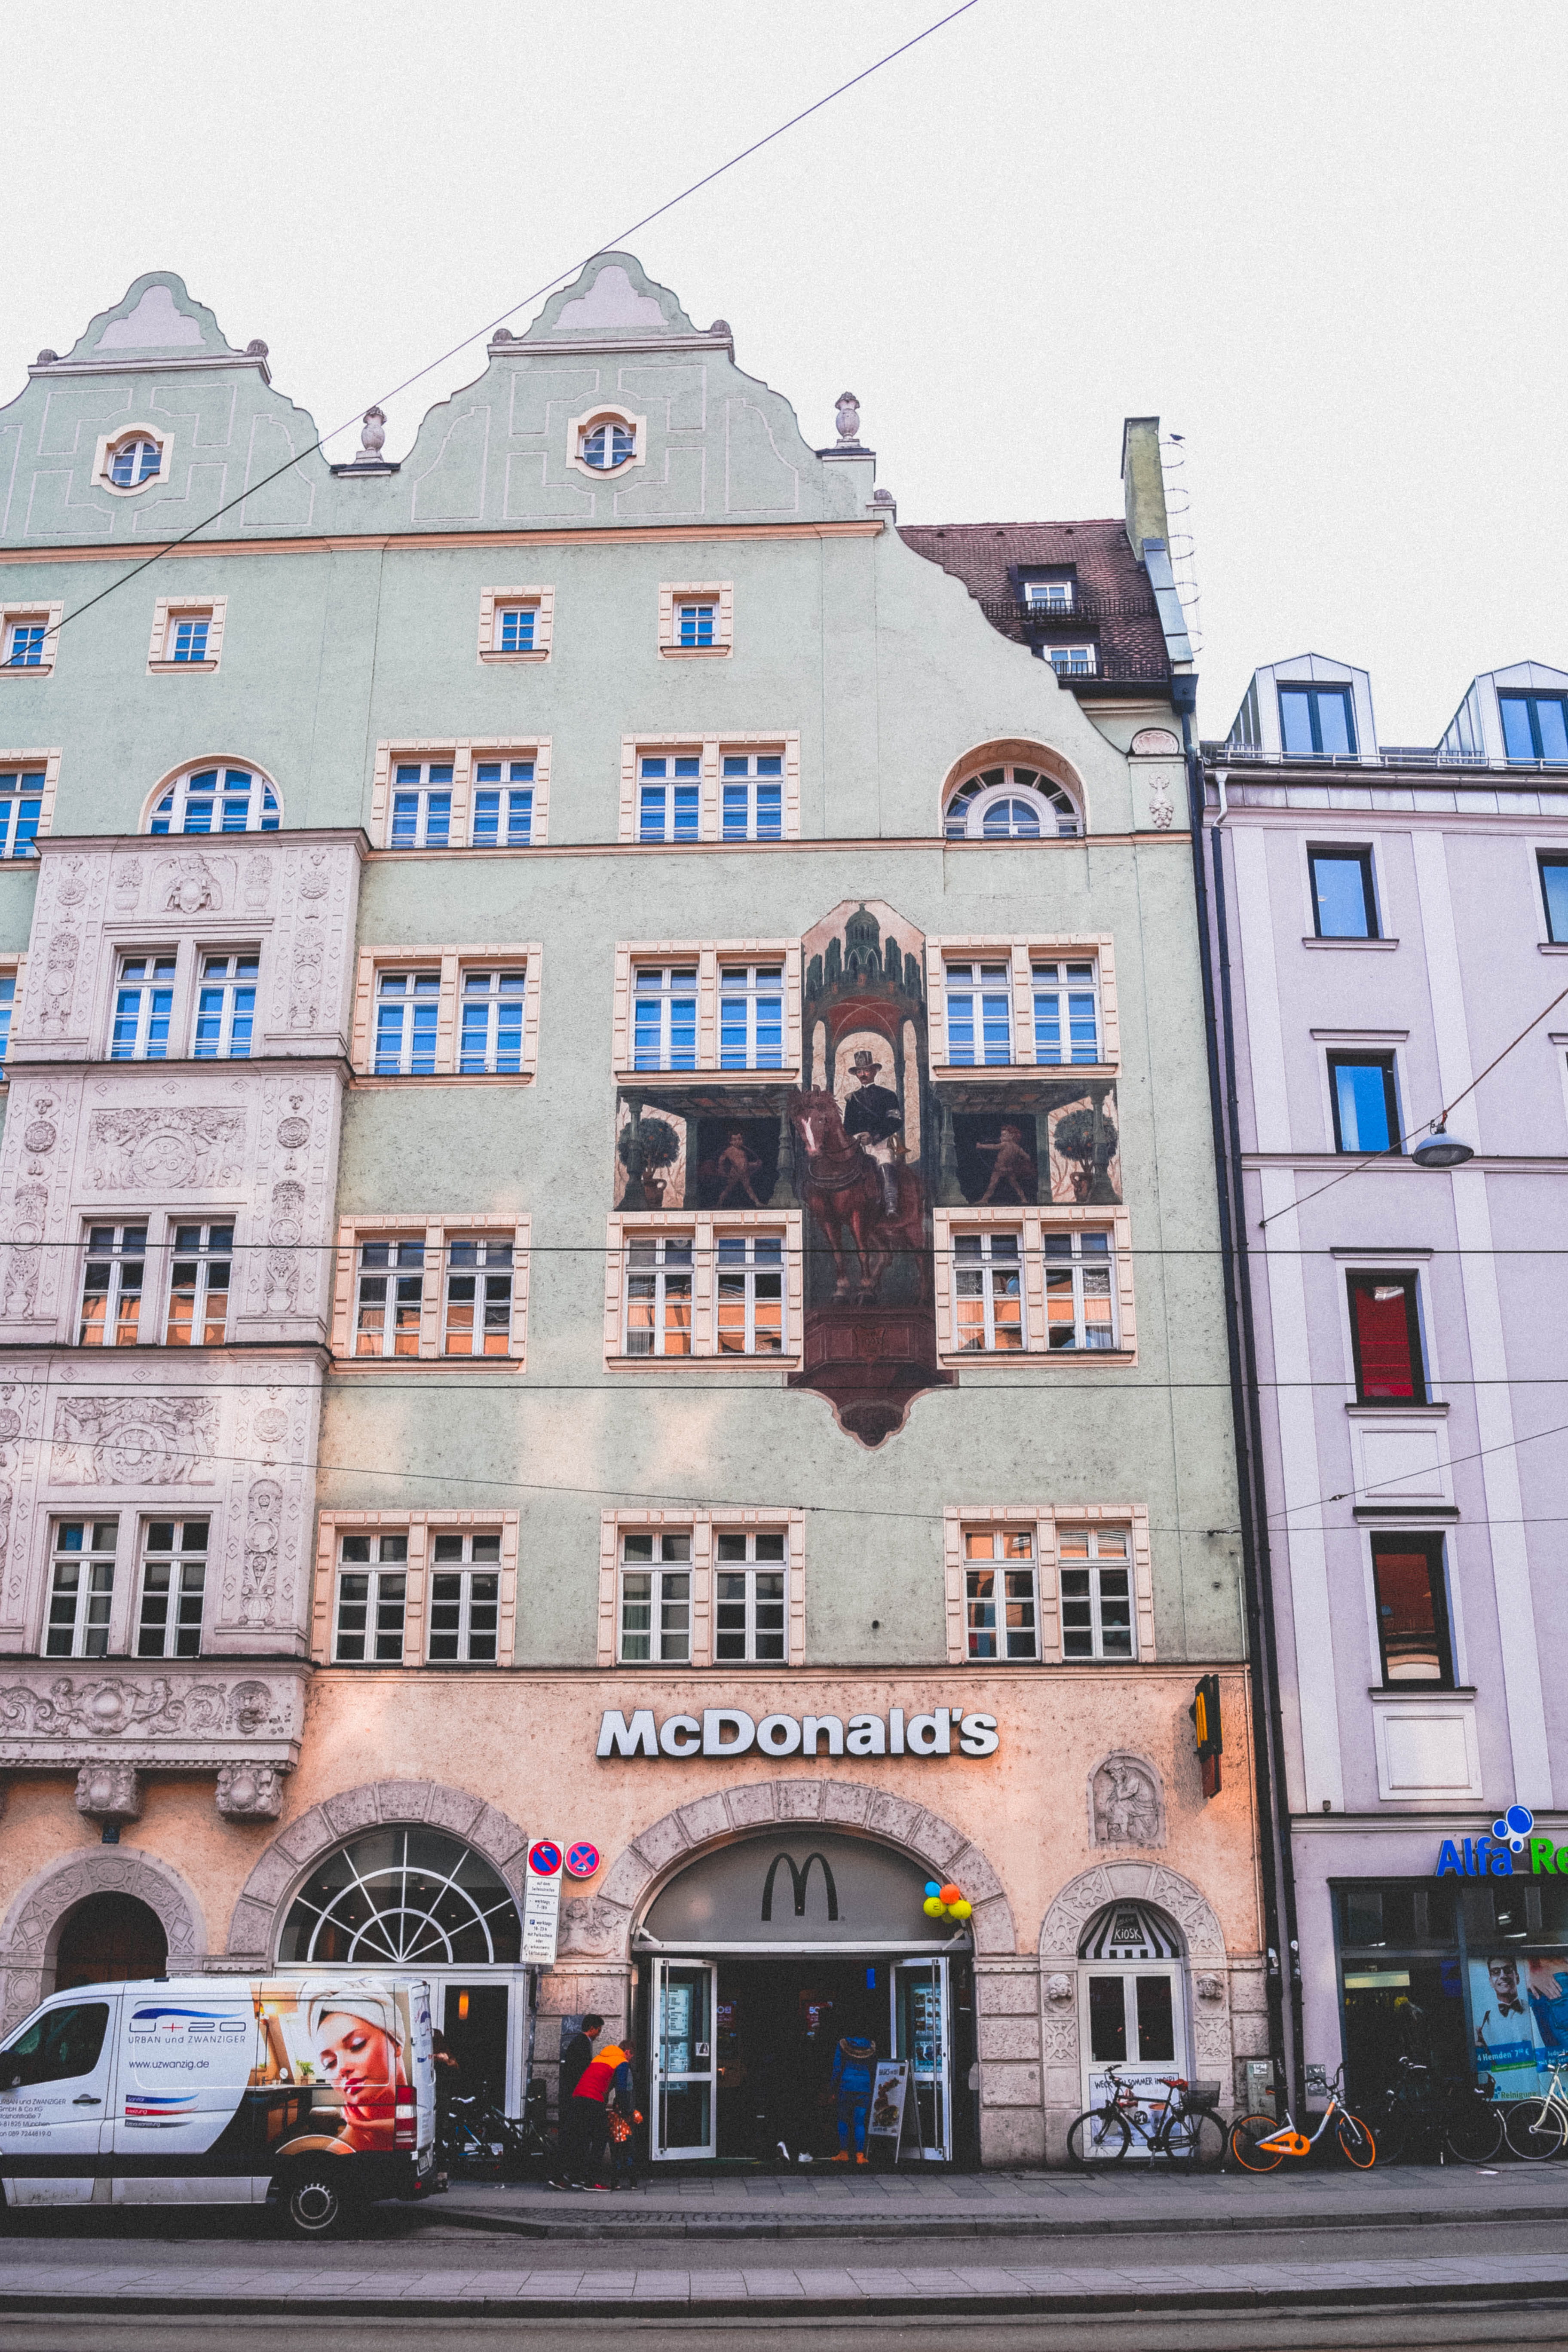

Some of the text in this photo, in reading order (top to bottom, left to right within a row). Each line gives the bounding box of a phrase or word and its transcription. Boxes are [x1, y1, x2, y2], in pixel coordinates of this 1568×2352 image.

[596, 1708, 1000, 1756] McDonald's
[1436, 1836, 1513, 1876] Alfa
[129, 2060, 209, 2070] www.uzwanzig.de
[1128, 2076, 1152, 2086] SOMMER
